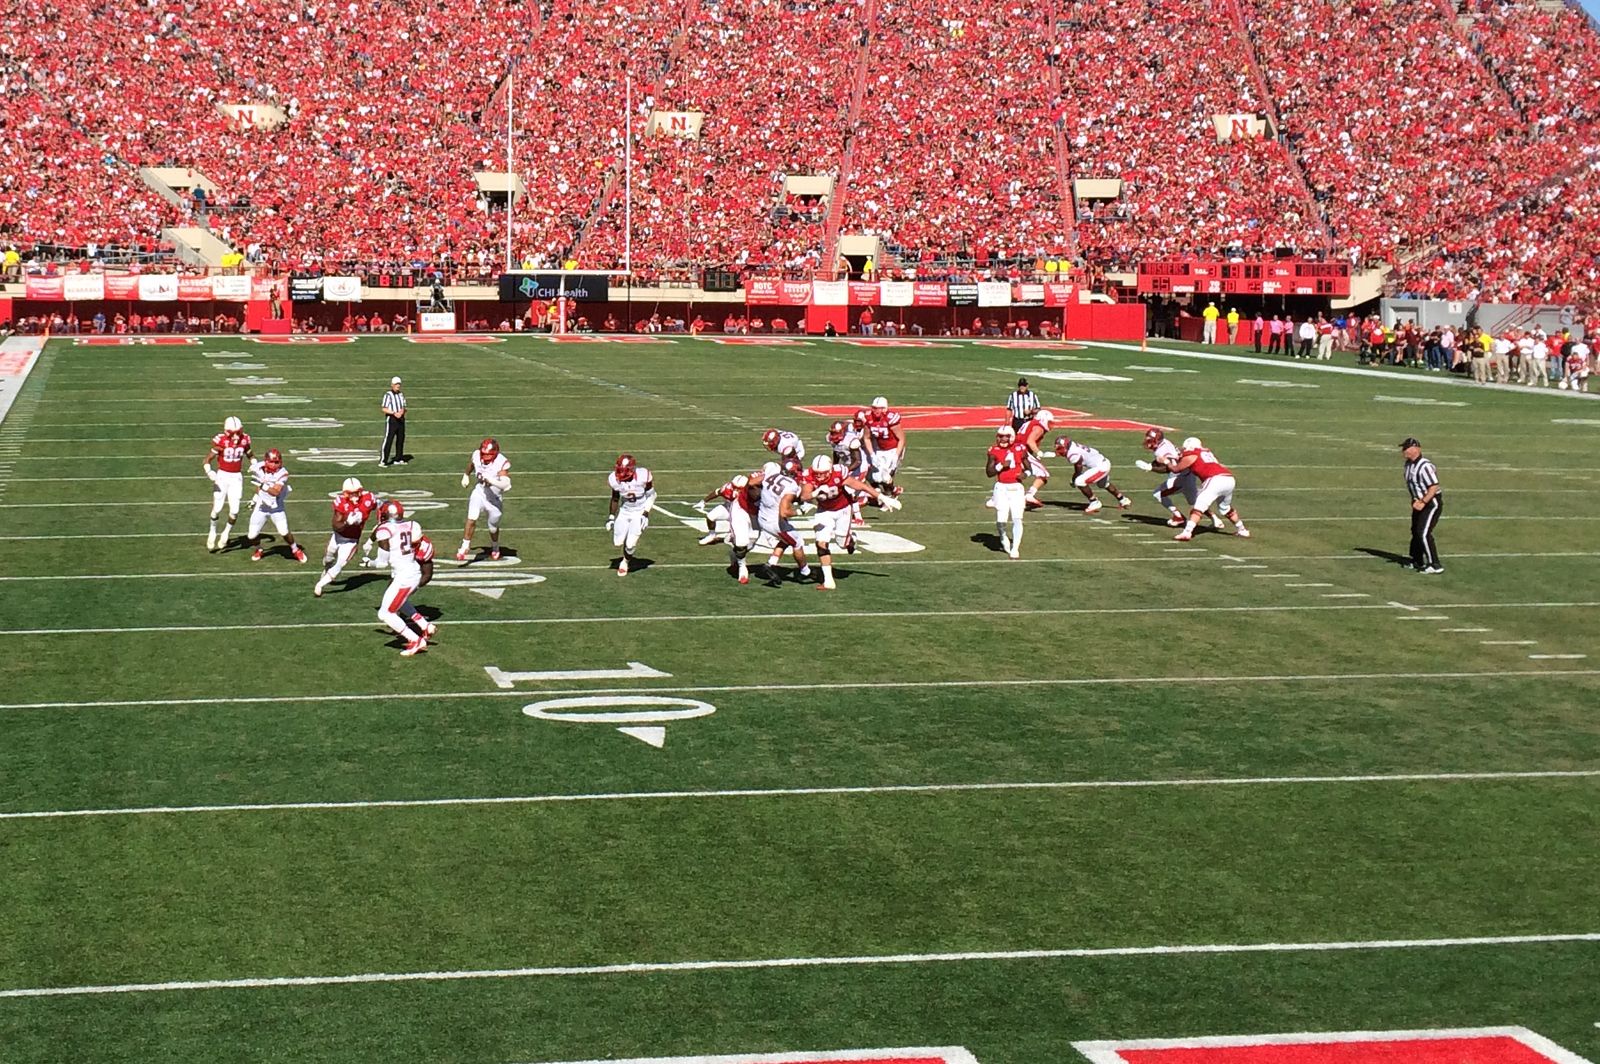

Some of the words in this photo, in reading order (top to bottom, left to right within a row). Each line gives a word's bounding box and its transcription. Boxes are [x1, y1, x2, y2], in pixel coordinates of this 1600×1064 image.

[237, 109, 254, 125] N
[671, 116, 687, 132] N
[1232, 118, 1248, 134] N
[538, 288, 555, 298] CHI
[753, 282, 773, 290] ROTC
[223, 446, 245, 463] 80
[765, 474, 793, 497] 45
[484, 661, 717, 723] 10
